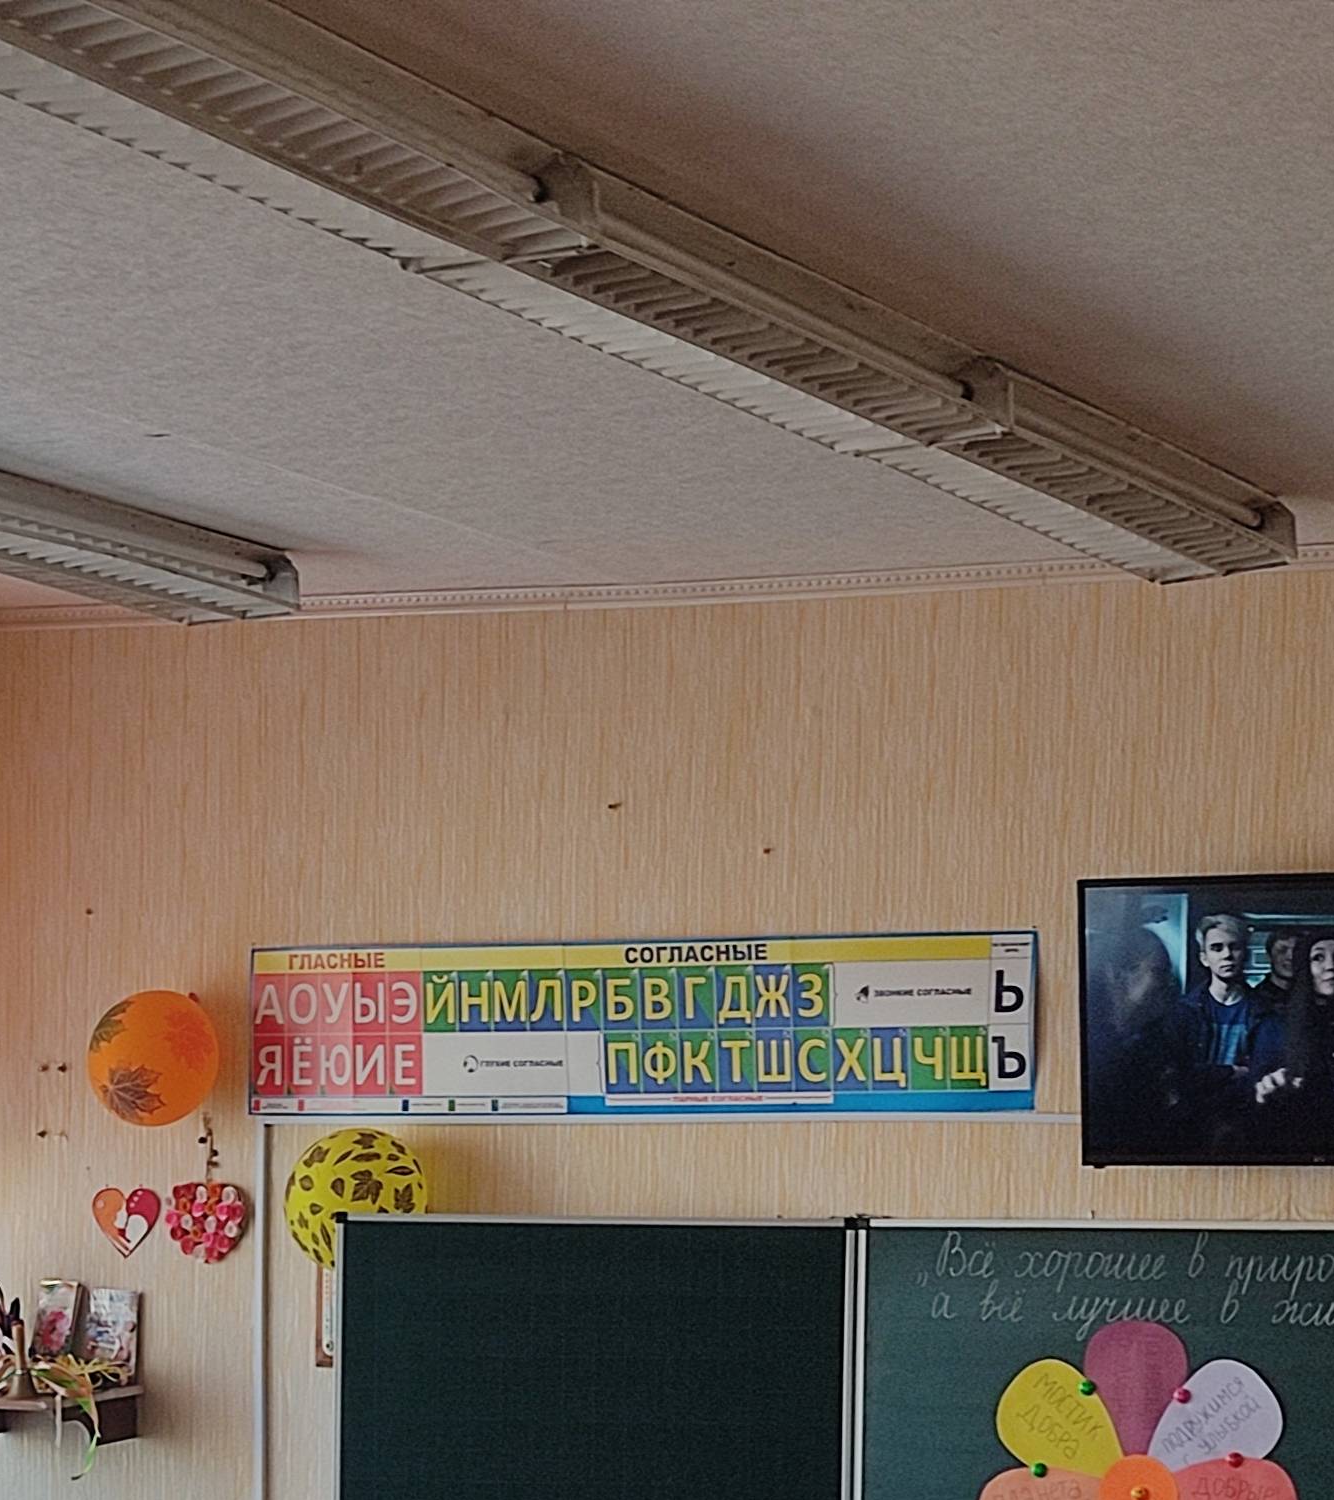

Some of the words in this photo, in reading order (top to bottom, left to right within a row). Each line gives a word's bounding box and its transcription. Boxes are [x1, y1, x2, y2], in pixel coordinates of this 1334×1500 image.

[287, 952, 386, 971] ГЛАСНЫЕ
[624, 943, 768, 965] СОГЛАСНЫЕ
[1014, 1250, 1166, 1293] хорошее
[1187, 1232, 1208, 1278] в
[930, 1291, 957, 1319] а
[979, 1279, 1027, 1322] всё
[1052, 1295, 1191, 1342] лучшее
[1219, 1279, 1240, 1325] в
